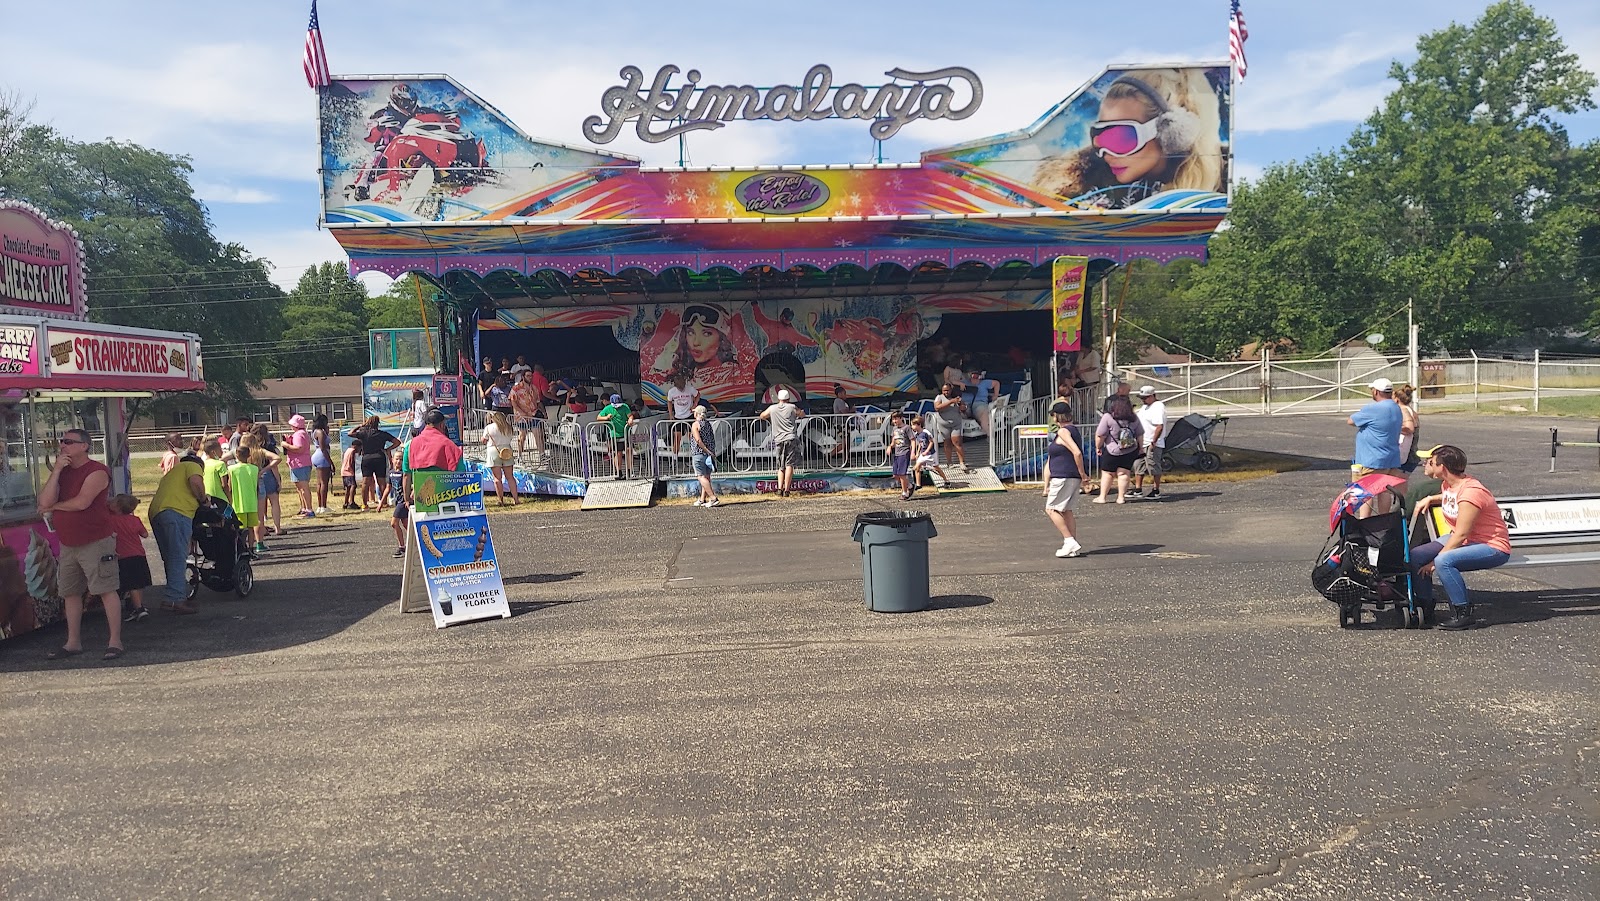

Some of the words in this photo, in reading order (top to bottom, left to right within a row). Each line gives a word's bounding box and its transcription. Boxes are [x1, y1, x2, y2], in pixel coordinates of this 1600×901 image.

[582, 64, 983, 143] Himalaya
[759, 175, 805, 193] Enjoy
[746, 197, 769, 211] the
[771, 186, 818, 208] Ride!
[74, 336, 169, 374] STRAWBERRIES
[371, 380, 426, 392] Himalaya
[425, 482, 481, 507] CHEESECAKE
[1515, 509, 1542, 522] NORTH
[1544, 509, 1580, 521] AMERICAN
[428, 559, 496, 578] STRAWBERRIES
[462, 572, 494, 581] CHOCOLATE
[456, 589, 500, 601] ROOTBEER
[465, 597, 496, 608] FLOATS
